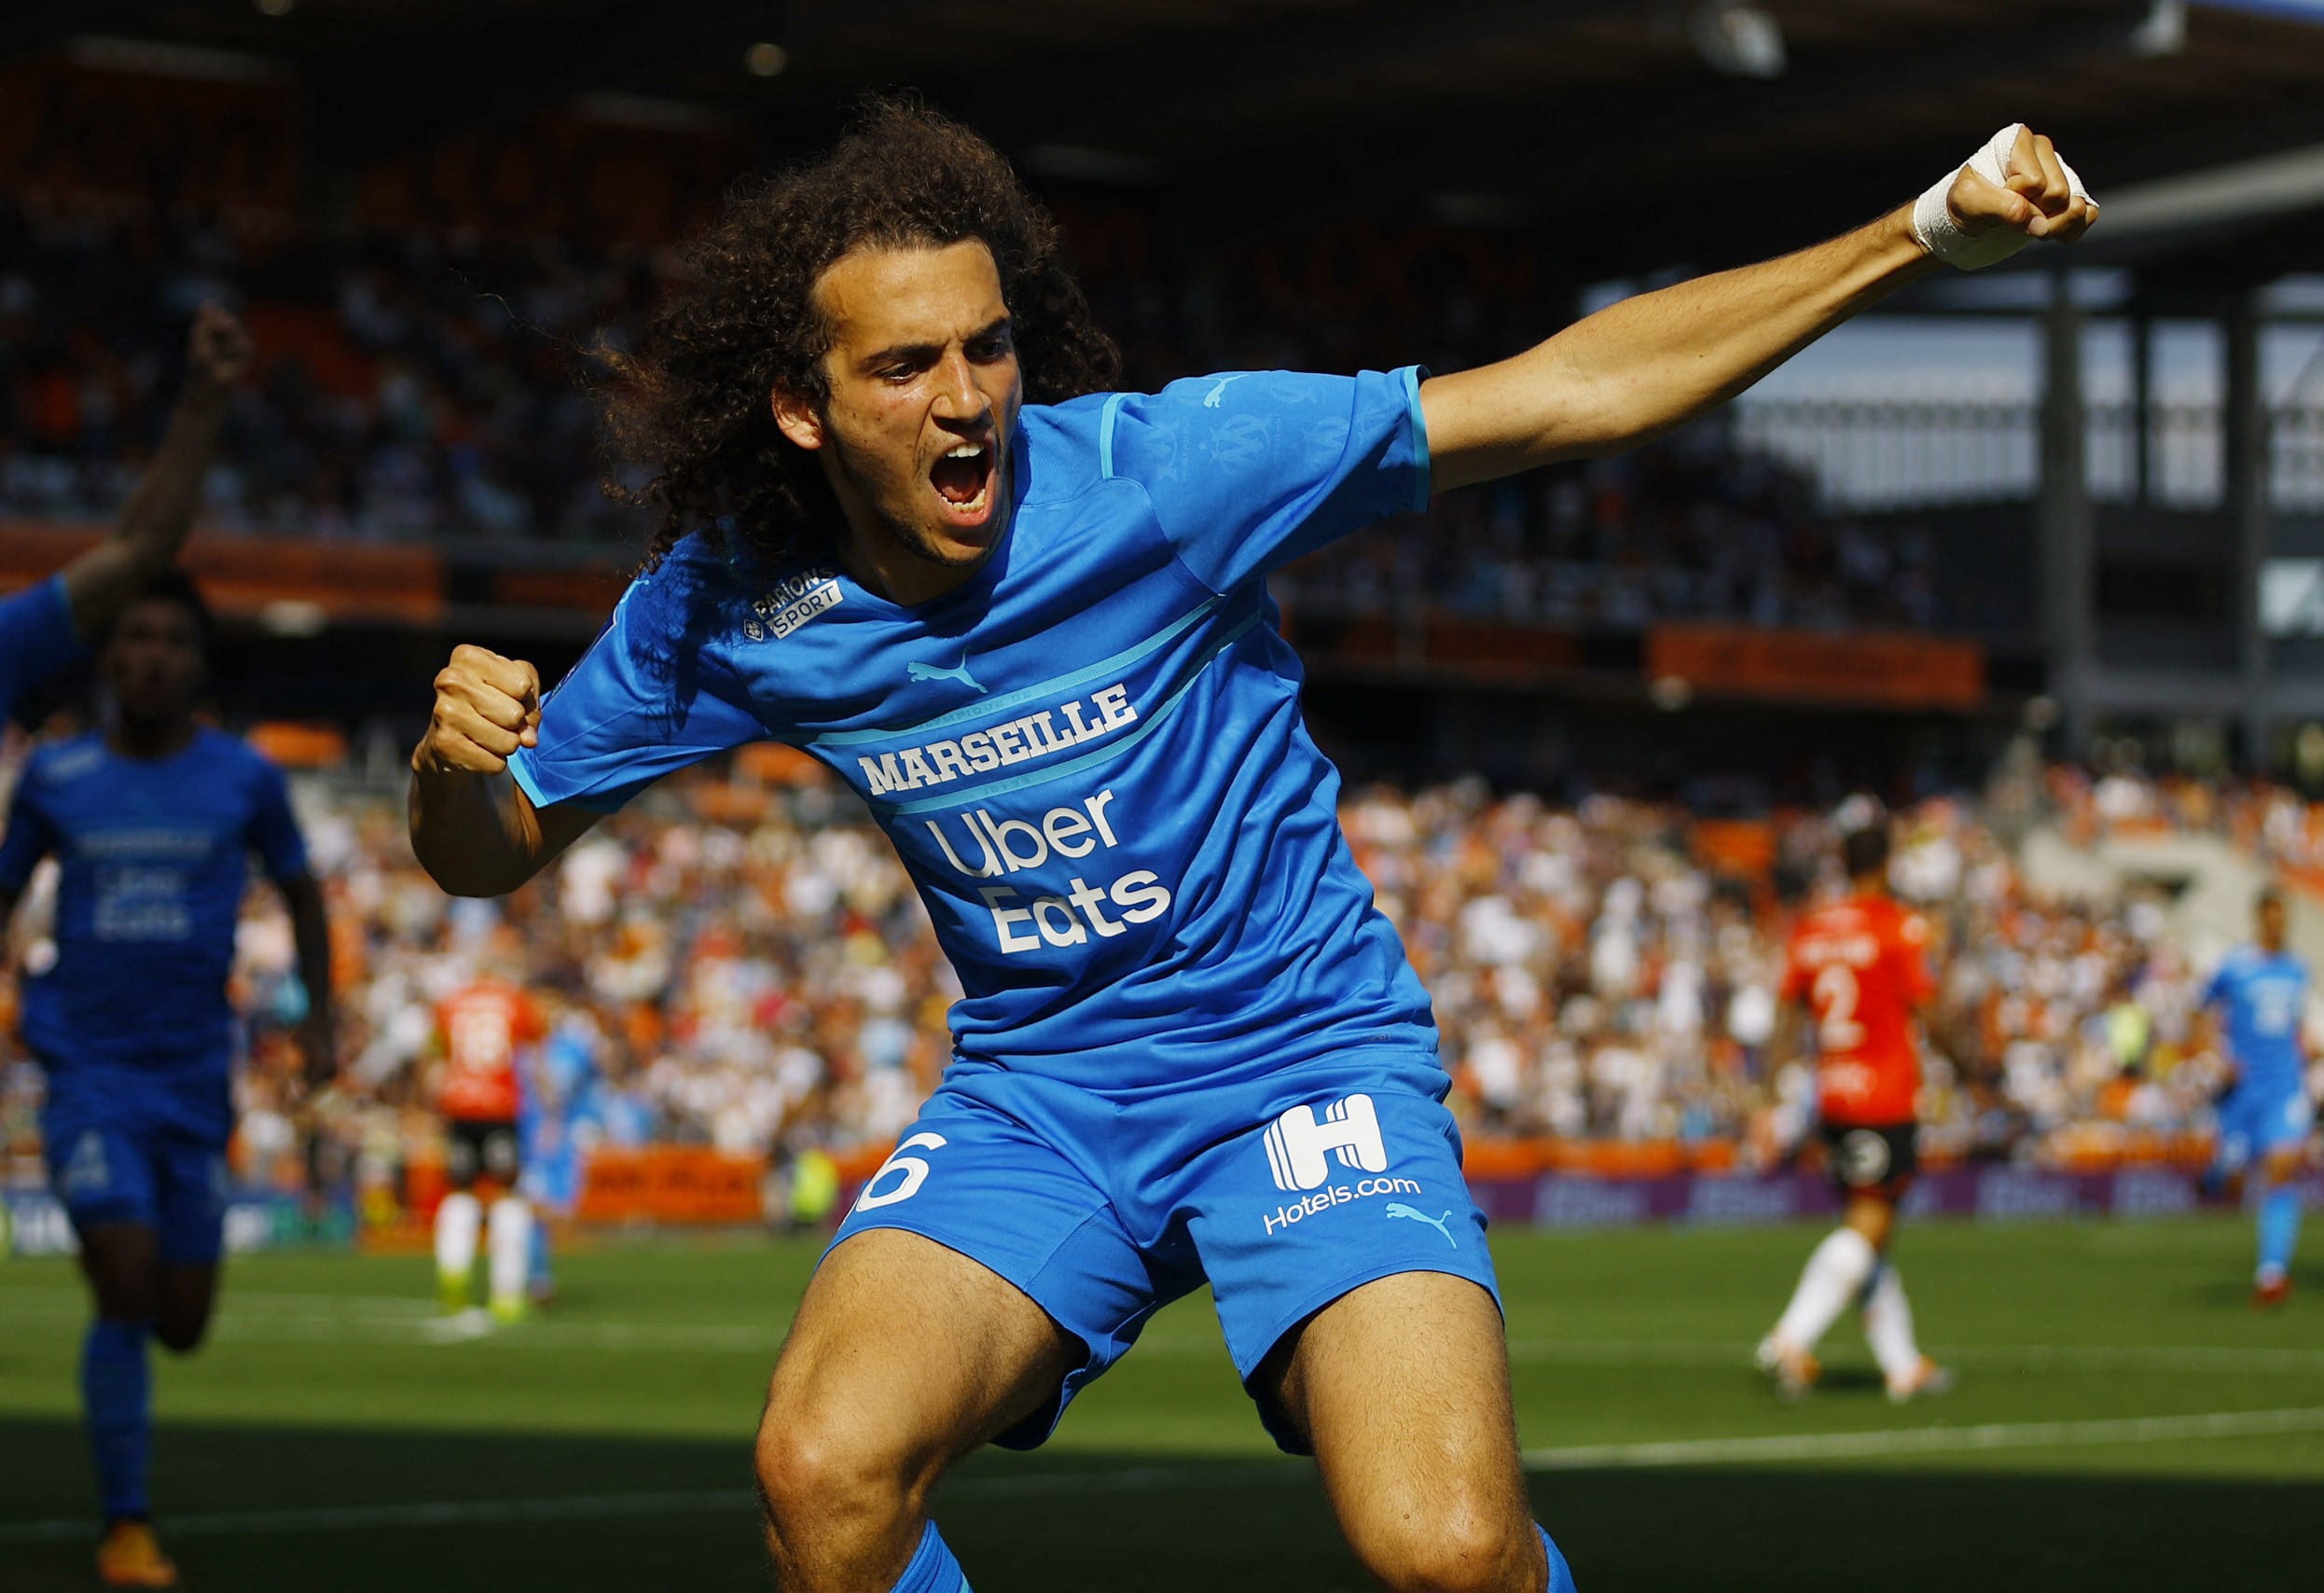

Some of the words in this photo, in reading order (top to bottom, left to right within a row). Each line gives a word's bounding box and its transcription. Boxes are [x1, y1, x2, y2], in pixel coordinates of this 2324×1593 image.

[773, 585, 836, 635] SPORT
[858, 684, 1139, 796] MARSEILLE
[925, 789, 1119, 879] Uber
[979, 869, 1172, 955] Eats
[1812, 963, 1866, 1053] 2
[854, 1131, 948, 1212] 6
[1263, 1177, 1423, 1237] Hotels.com
